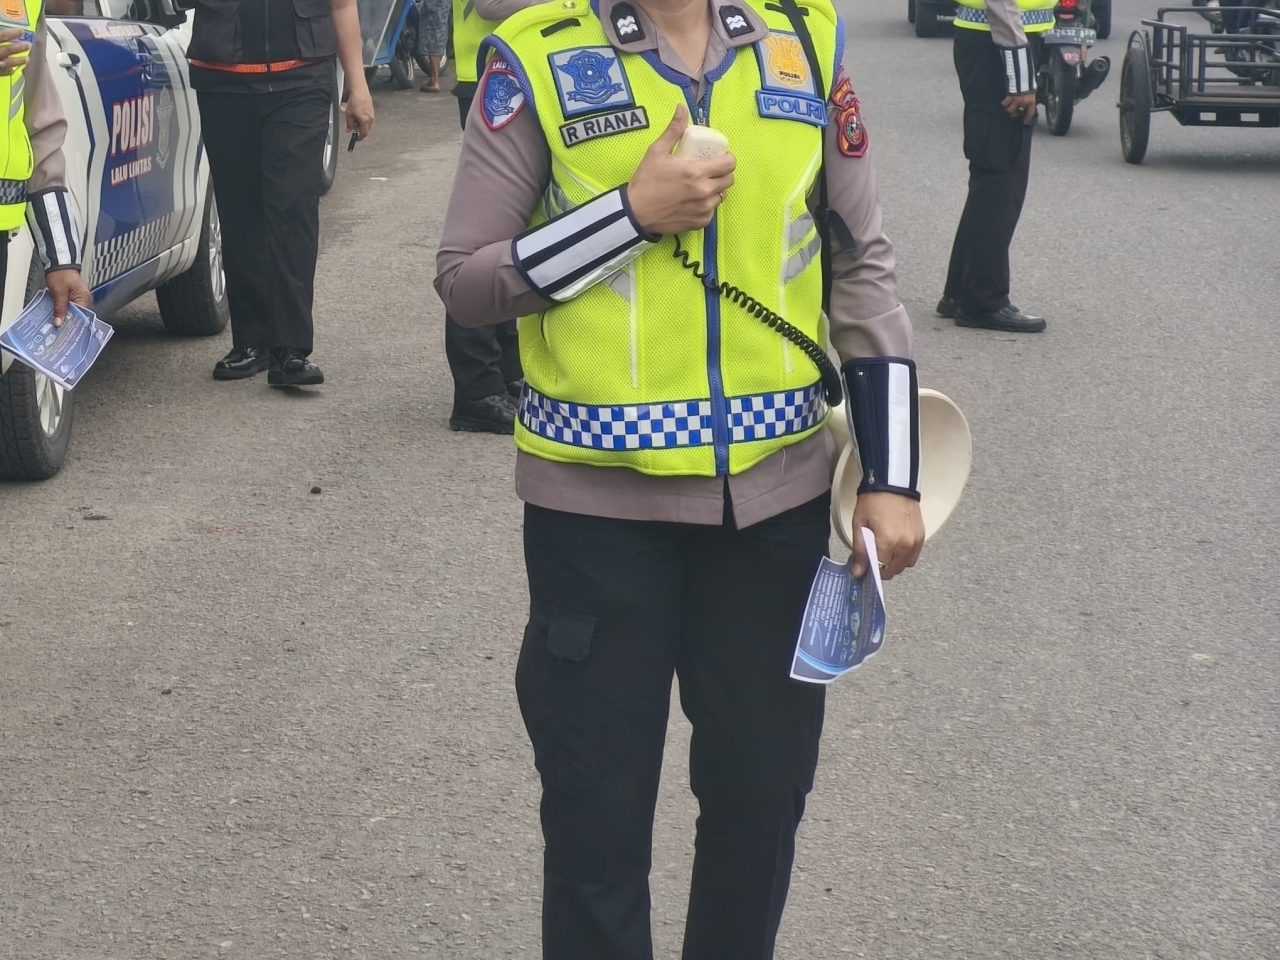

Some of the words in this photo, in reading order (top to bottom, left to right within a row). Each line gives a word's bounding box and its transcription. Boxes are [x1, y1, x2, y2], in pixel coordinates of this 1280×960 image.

[762, 96, 823, 121] POLRI
[111, 94, 155, 157] POLISI
[566, 126, 579, 143] R
[583, 111, 642, 137] RIANA
[111, 164, 128, 185] LALU
[128, 156, 152, 179] LINTAS
